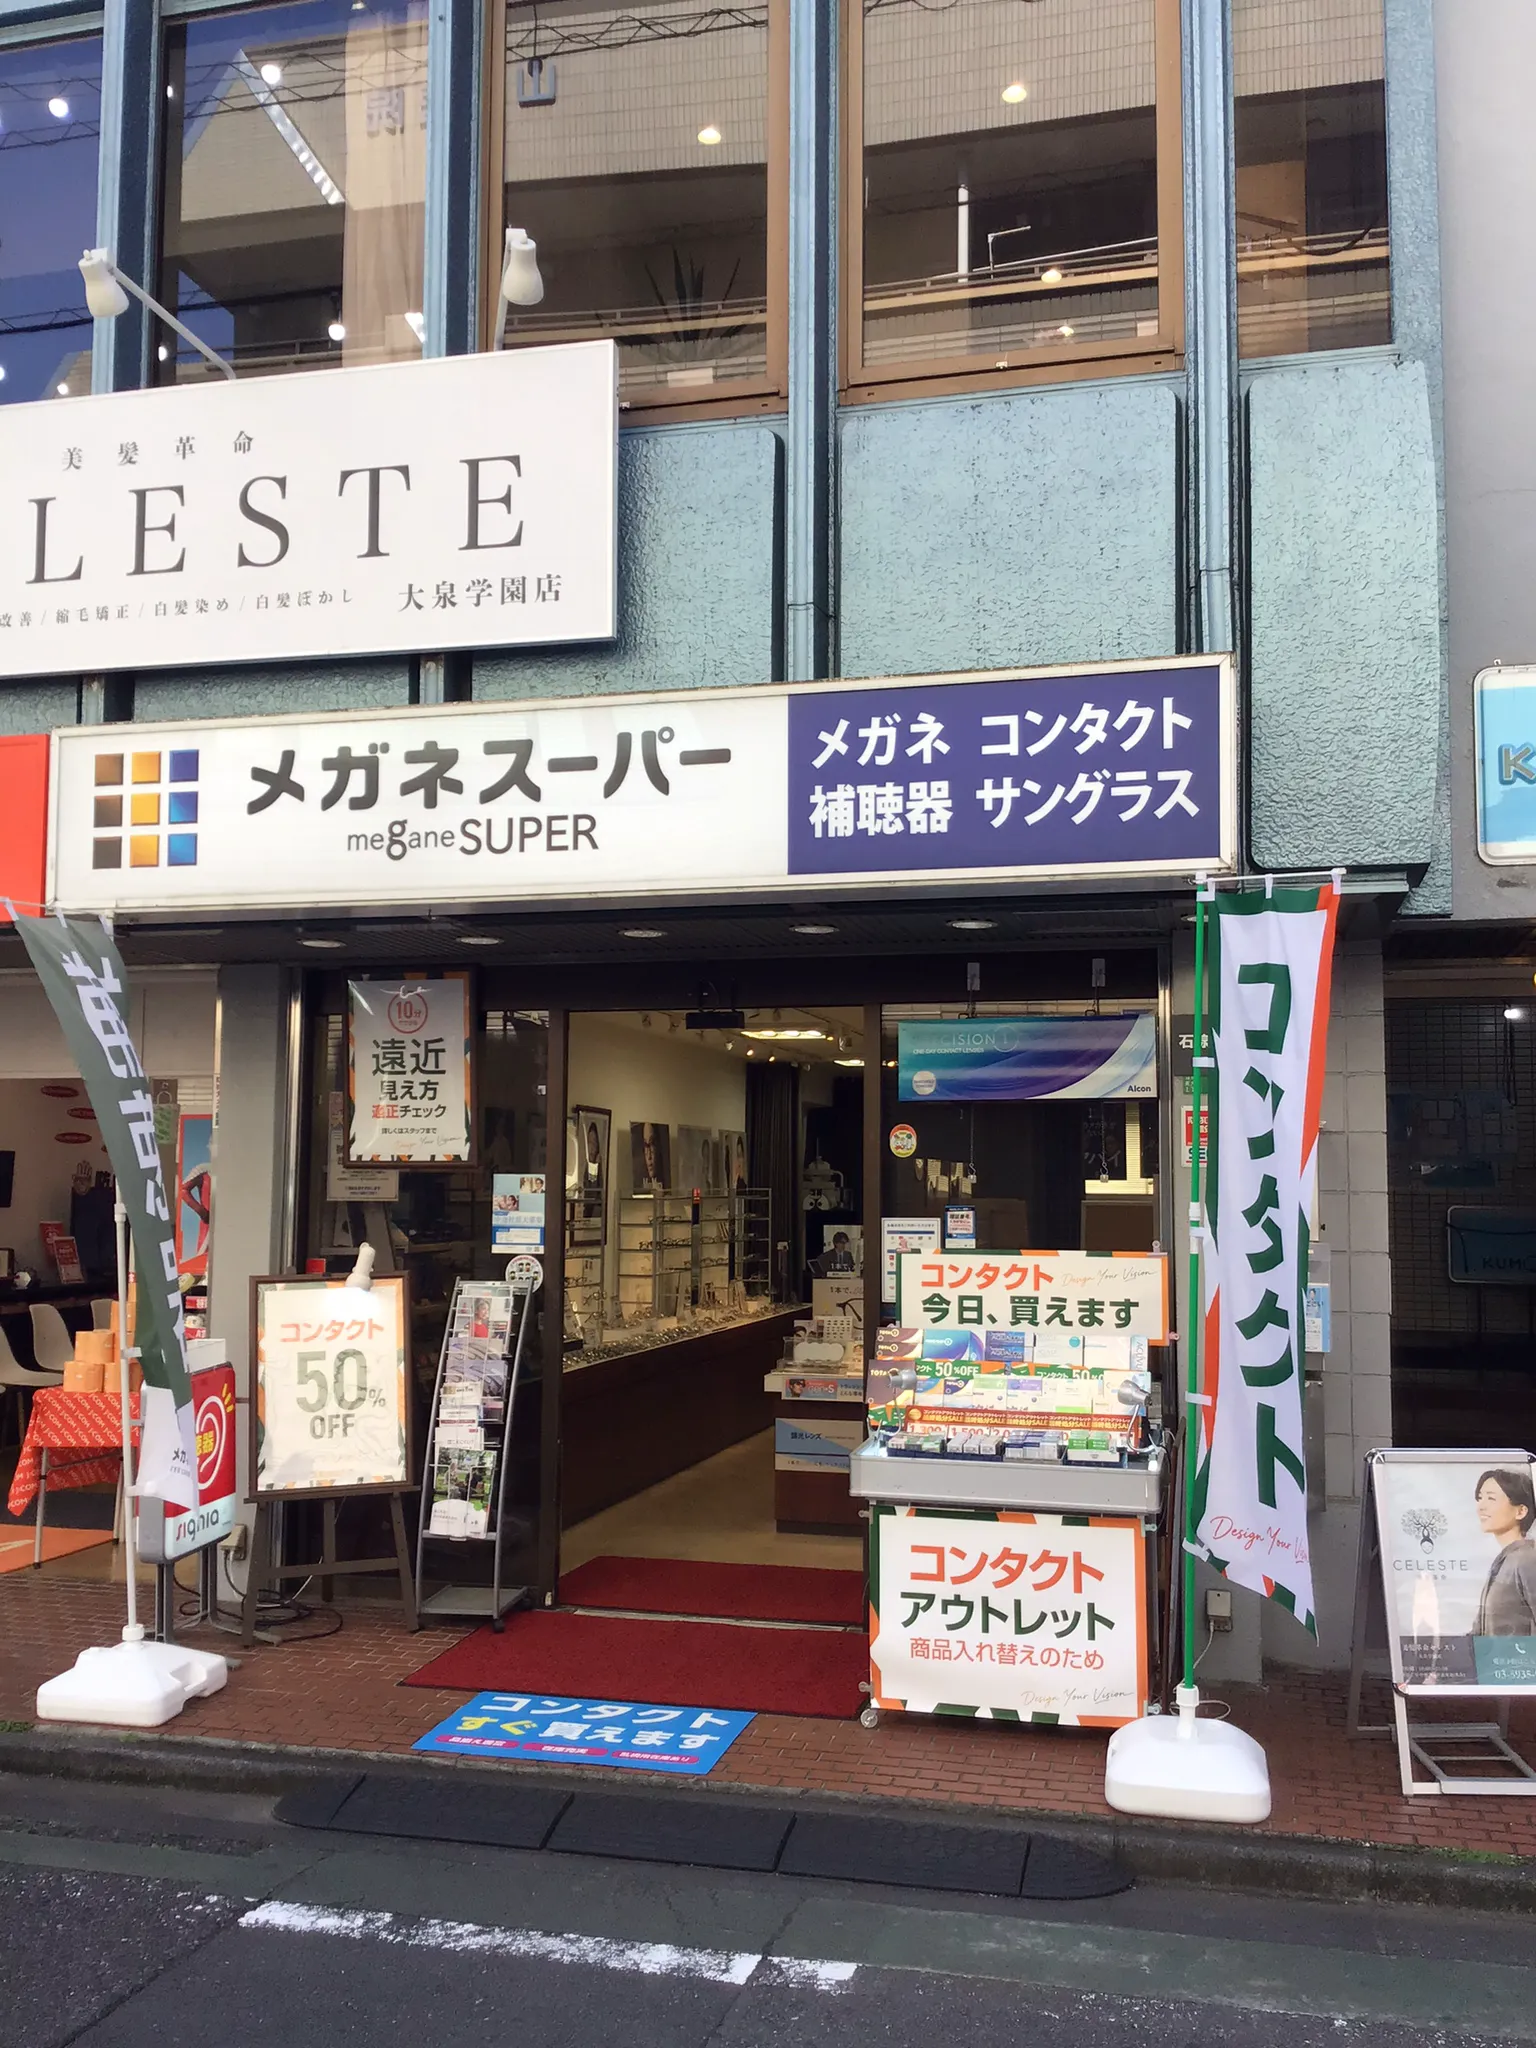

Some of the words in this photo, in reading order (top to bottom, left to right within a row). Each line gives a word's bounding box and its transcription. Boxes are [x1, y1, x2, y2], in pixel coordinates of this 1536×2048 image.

[61, 430, 255, 471] 美髪革命
[25, 454, 524, 585] LESTE
[397, 574, 563, 613] 大泉学園店
[811, 712, 951, 770] メガネ
[981, 696, 1193, 758] コンタクト
[247, 731, 732, 815] メガネスーパー
[809, 780, 953, 839] 補聴器
[975, 769, 1200, 829] サングラス
[372, 1037, 446, 1076] 遠近
[379, 1079, 439, 1101] 見え方
[1127, 1084, 1152, 1093] Alcon
[1238, 963, 1304, 1508] コンタクト
[921, 1262, 1054, 1291] コンタクト
[1062, 1273, 1095, 1287] Design
[1097, 1268, 1118, 1282] Your
[1122, 1266, 1155, 1281] Vision
[921, 1293, 1139, 1329] 今日、買えます
[281, 1319, 384, 1343] コンタクト
[310, 1413, 355, 1440] OFF
[1210, 1516, 1264, 1550] Design
[1267, 1526, 1291, 1555] Your
[911, 1545, 1104, 1594] コンタクト
[1393, 1560, 1468, 1571] CELESTE
[901, 1592, 1115, 1641] アウトレット
[910, 1638, 1104, 1670] 商品入れ替えのため
[480, 1696, 730, 1729] コンタクト
[1021, 1691, 1058, 1706] Design
[1063, 1689, 1088, 1706] Your
[1093, 1686, 1134, 1704] Vision
[456, 1716, 720, 1750] すぐ買えます
